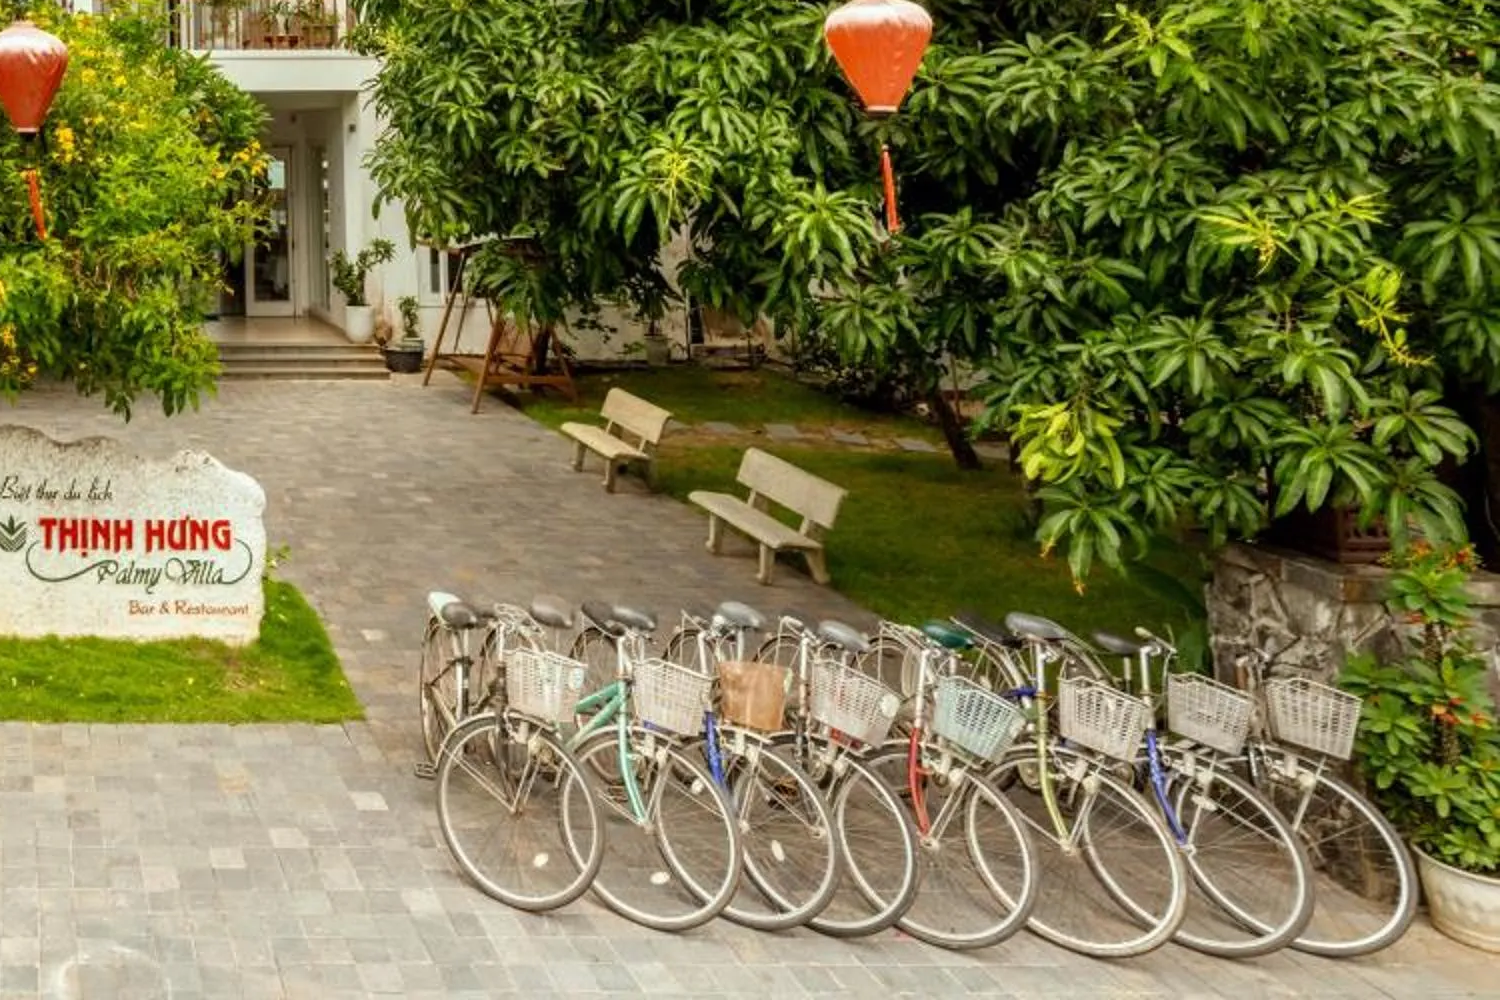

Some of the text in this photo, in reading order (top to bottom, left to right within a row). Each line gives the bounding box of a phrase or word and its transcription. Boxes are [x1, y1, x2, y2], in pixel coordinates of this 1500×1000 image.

[63, 477, 81, 500] du
[39, 514, 232, 558] THỊNH HƯNG
[97, 557, 226, 594] Palmy Villa
[129, 600, 249, 615] Bar & Restaurant
